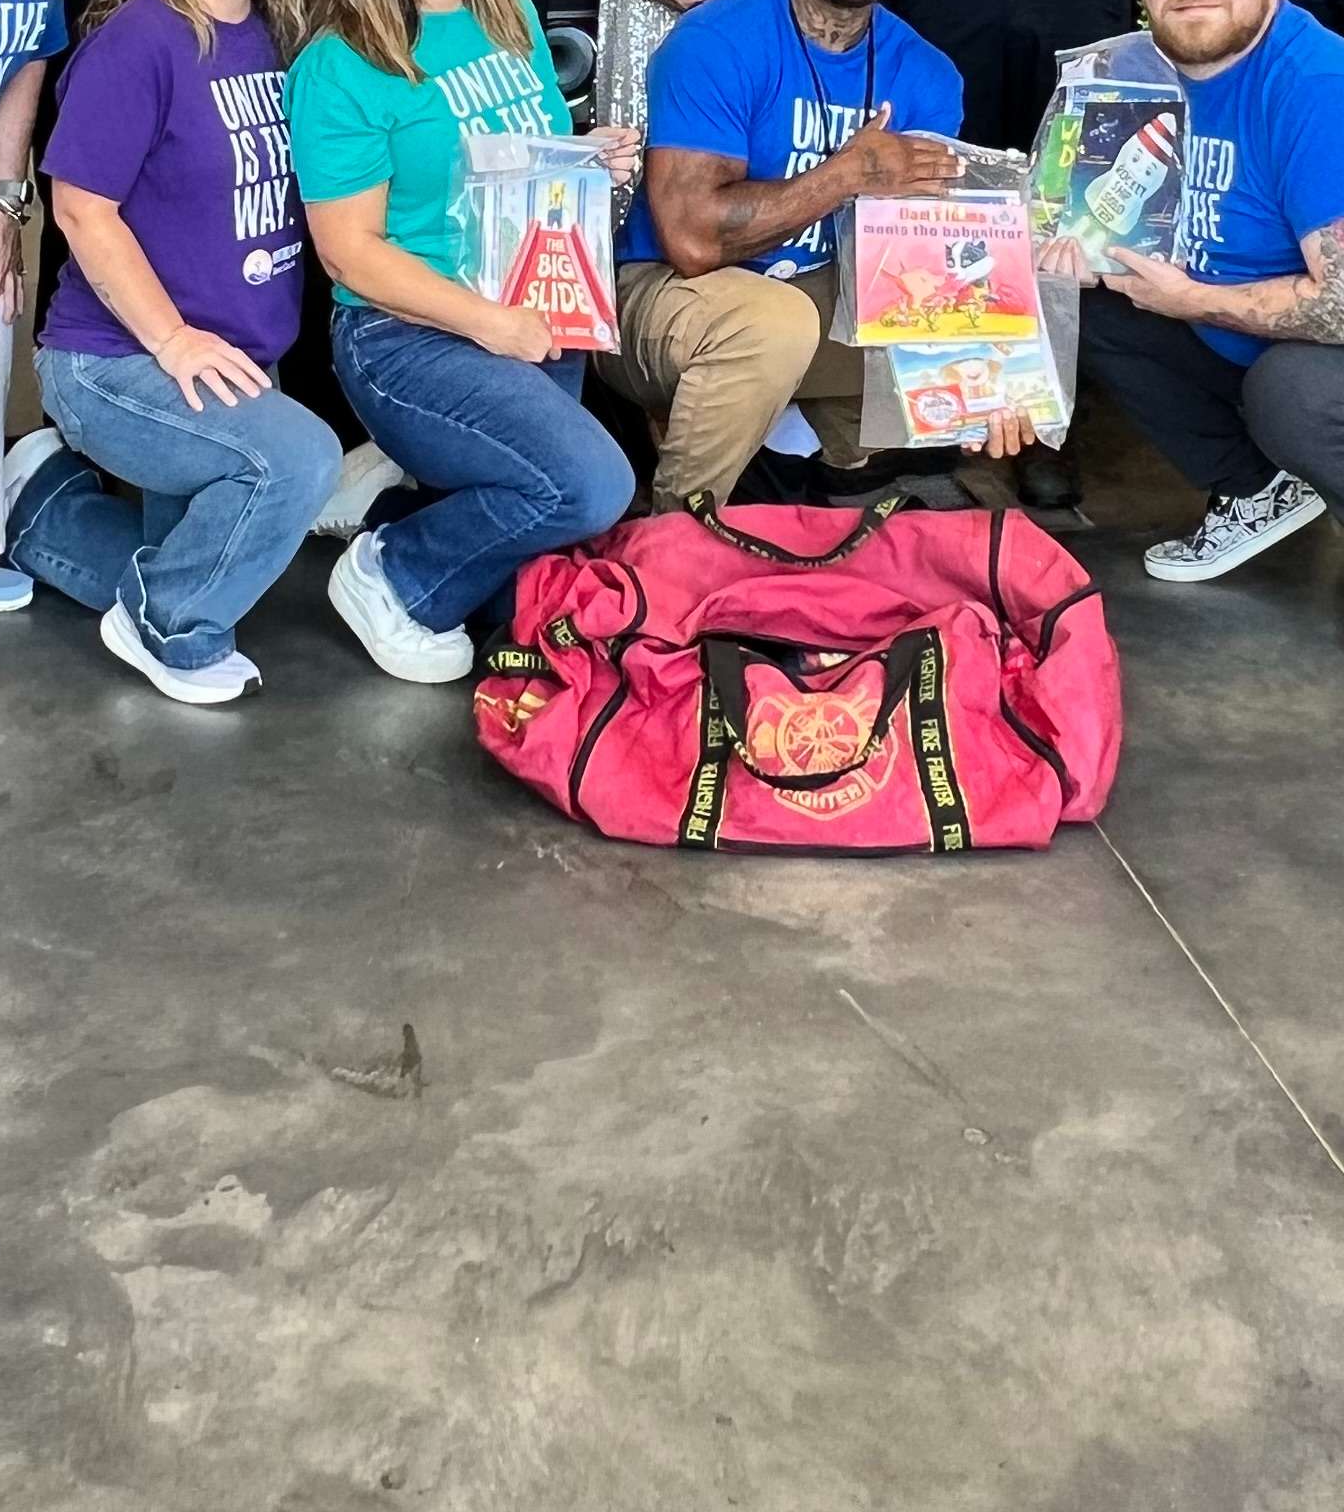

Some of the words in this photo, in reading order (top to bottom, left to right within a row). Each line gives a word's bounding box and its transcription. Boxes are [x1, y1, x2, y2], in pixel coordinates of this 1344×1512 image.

[229, 129, 260, 187] IS
[258, 123, 296, 179] TH
[233, 177, 296, 242] WAY.
[913, 224, 938, 238] the
[942, 227, 1024, 241] babysitter
[536, 253, 577, 280] BIG
[522, 280, 592, 316] SLIDE
